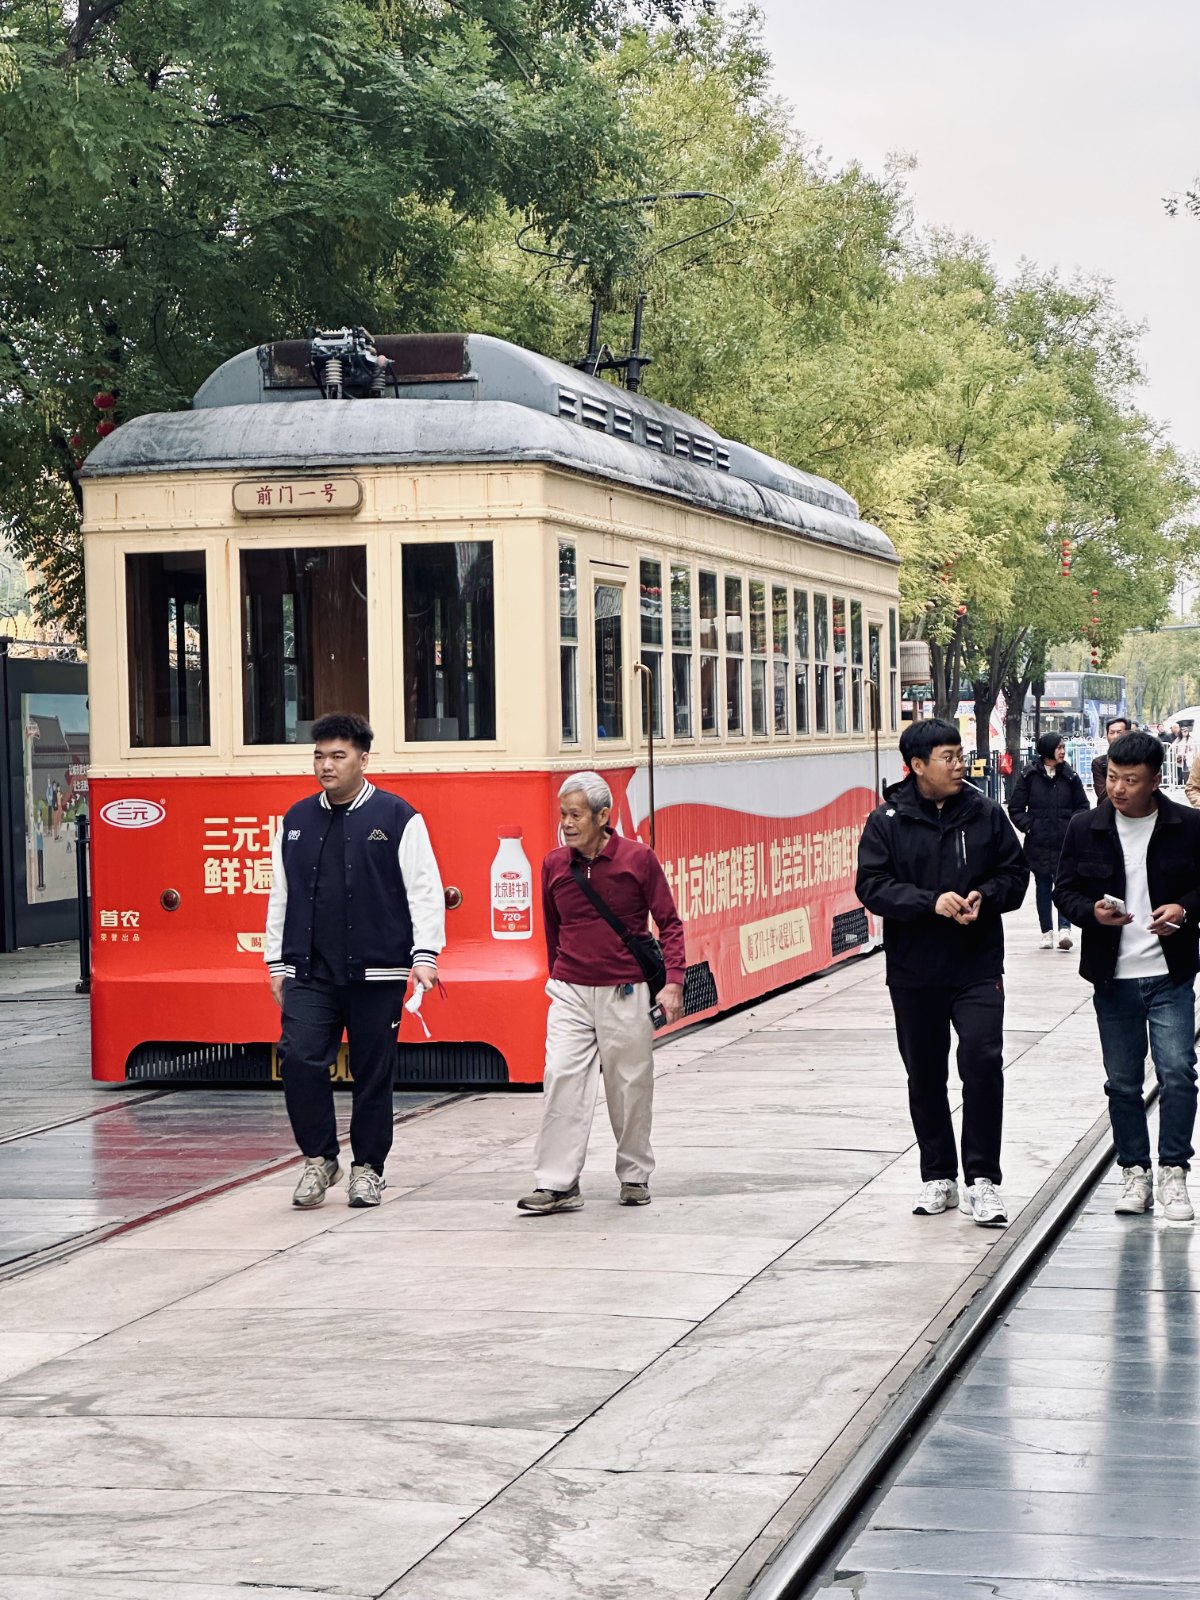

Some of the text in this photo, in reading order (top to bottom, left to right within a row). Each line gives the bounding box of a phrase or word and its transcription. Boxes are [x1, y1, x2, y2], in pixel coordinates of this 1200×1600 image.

[256, 483, 337, 505] 前门一号
[117, 807, 148, 820] 三元
[770, 822, 867, 897] 也尝尝北京的新鲜味
[204, 857, 273, 895] 鲜遍
[494, 881, 529, 898] 北京鲜牛奶
[100, 910, 140, 927] 首农
